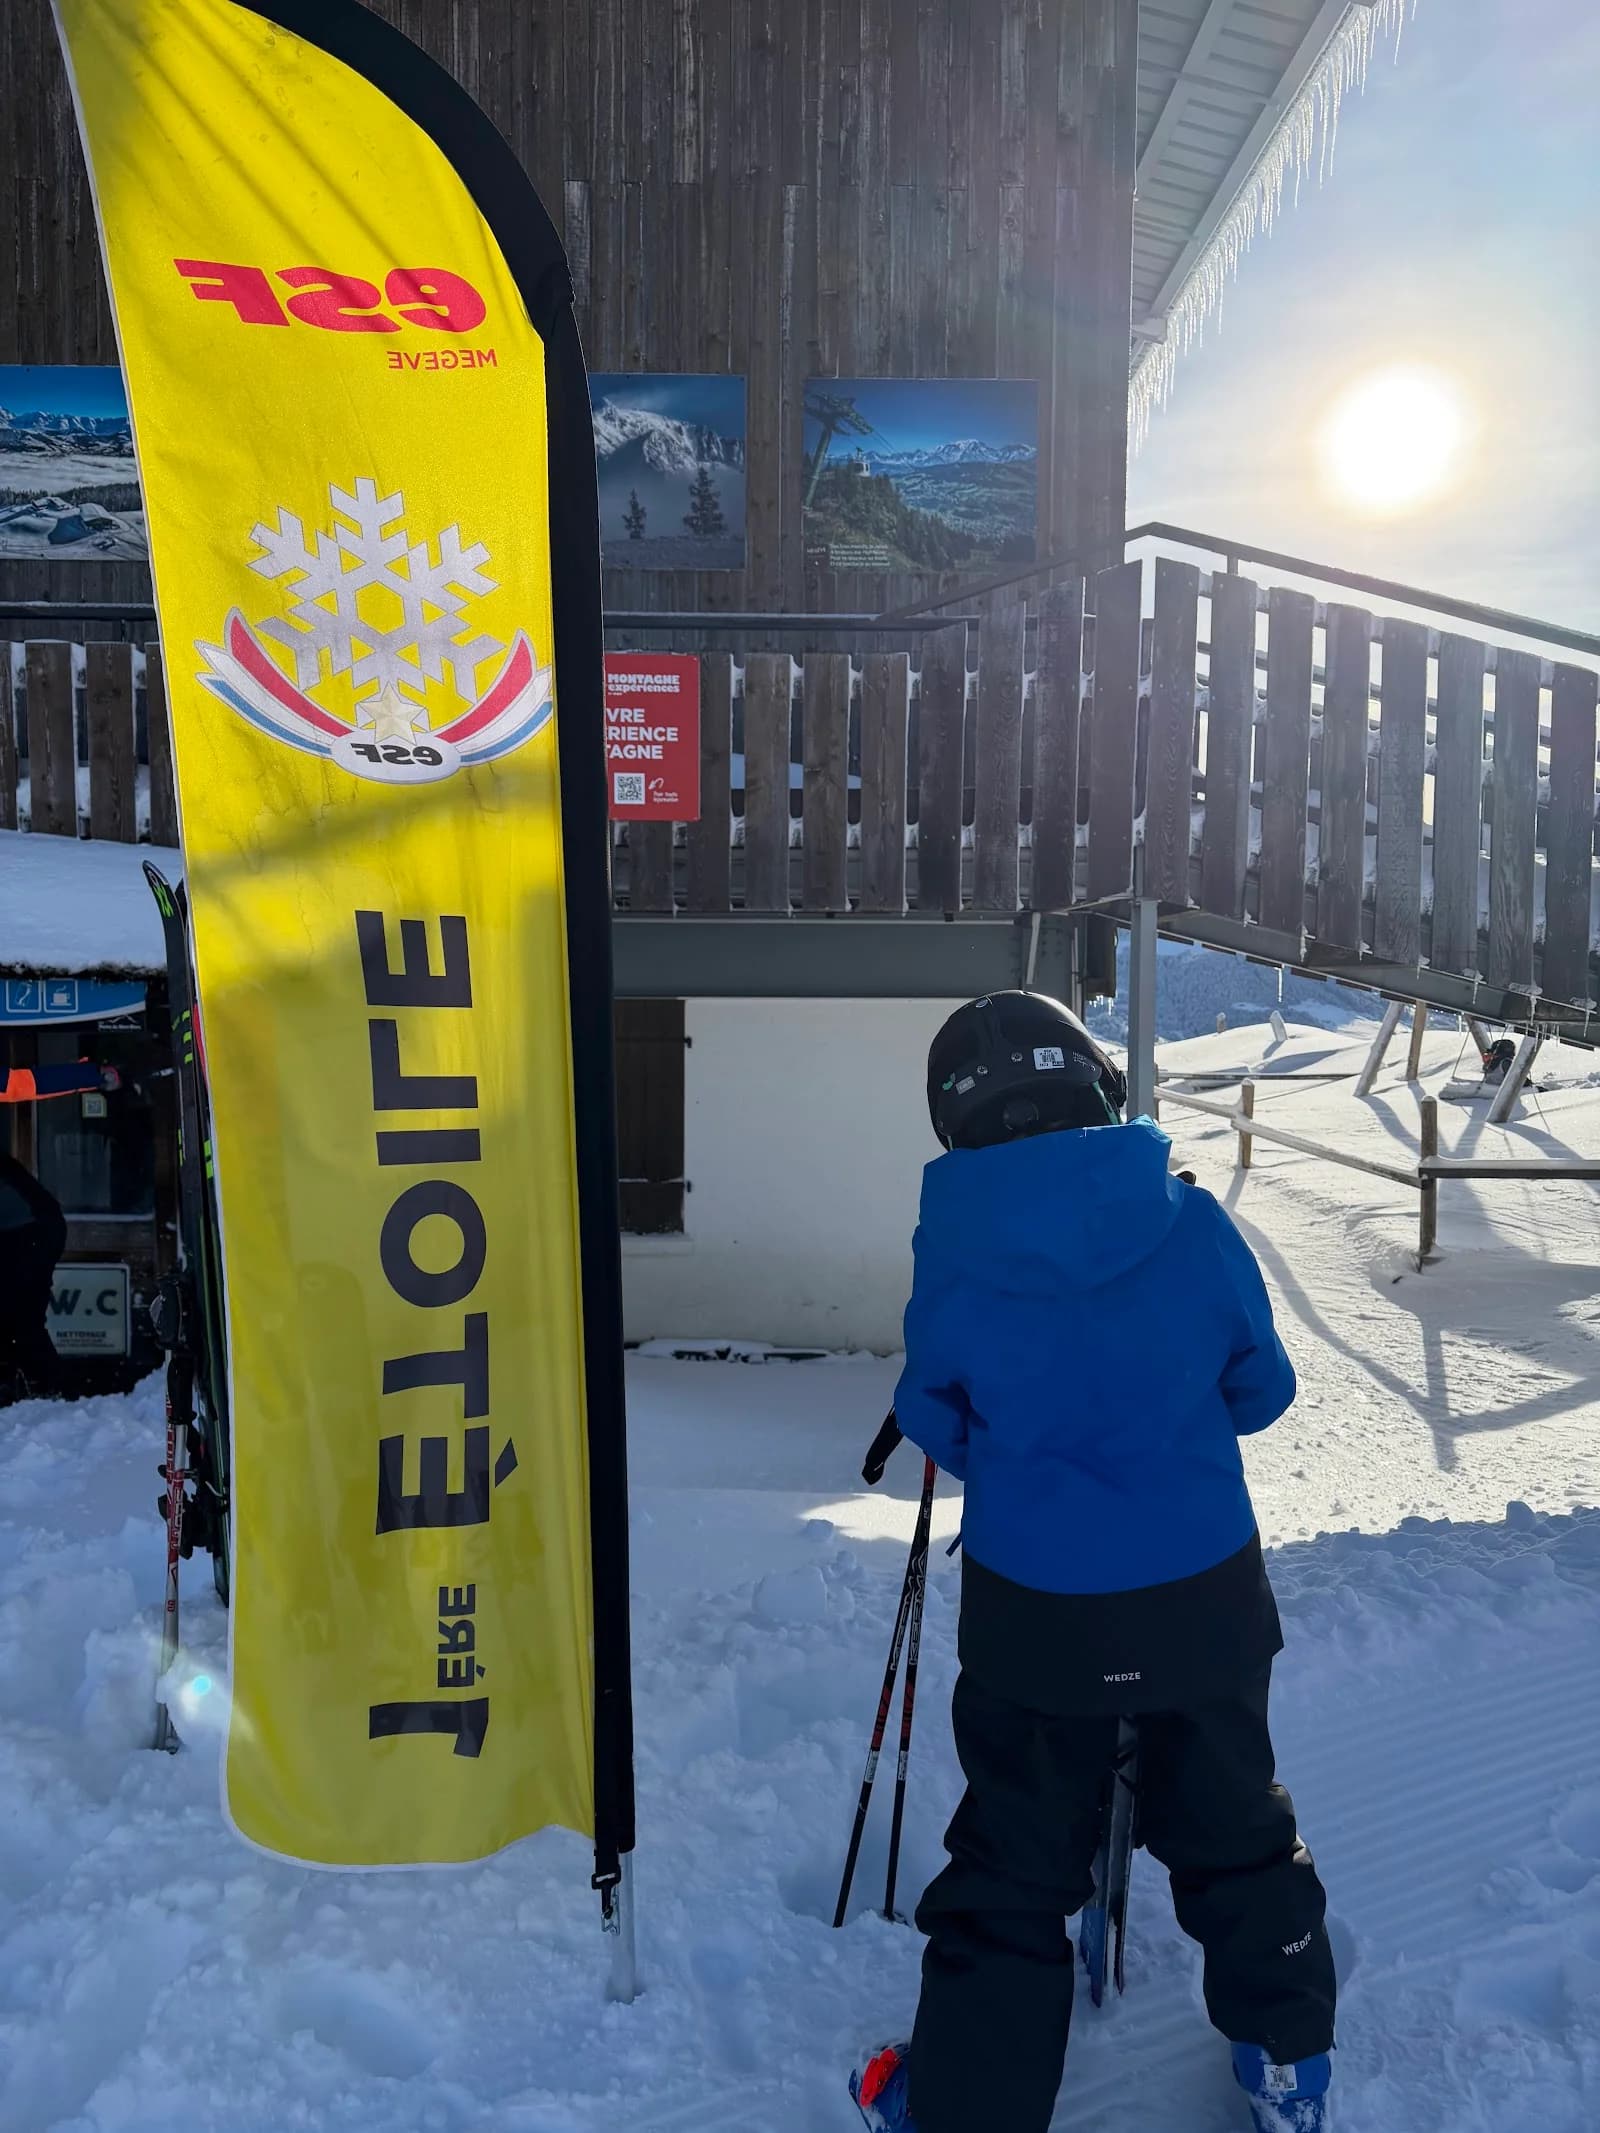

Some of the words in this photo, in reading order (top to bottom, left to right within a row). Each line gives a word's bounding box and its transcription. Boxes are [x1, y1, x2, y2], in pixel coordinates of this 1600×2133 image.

[607, 674, 680, 685] MONTAGNE
[606, 708, 645, 723] VRE
[607, 726, 679, 742] RIENCE
[606, 744, 664, 760] AGNE
[1103, 1671, 1141, 1683] WEDZE
